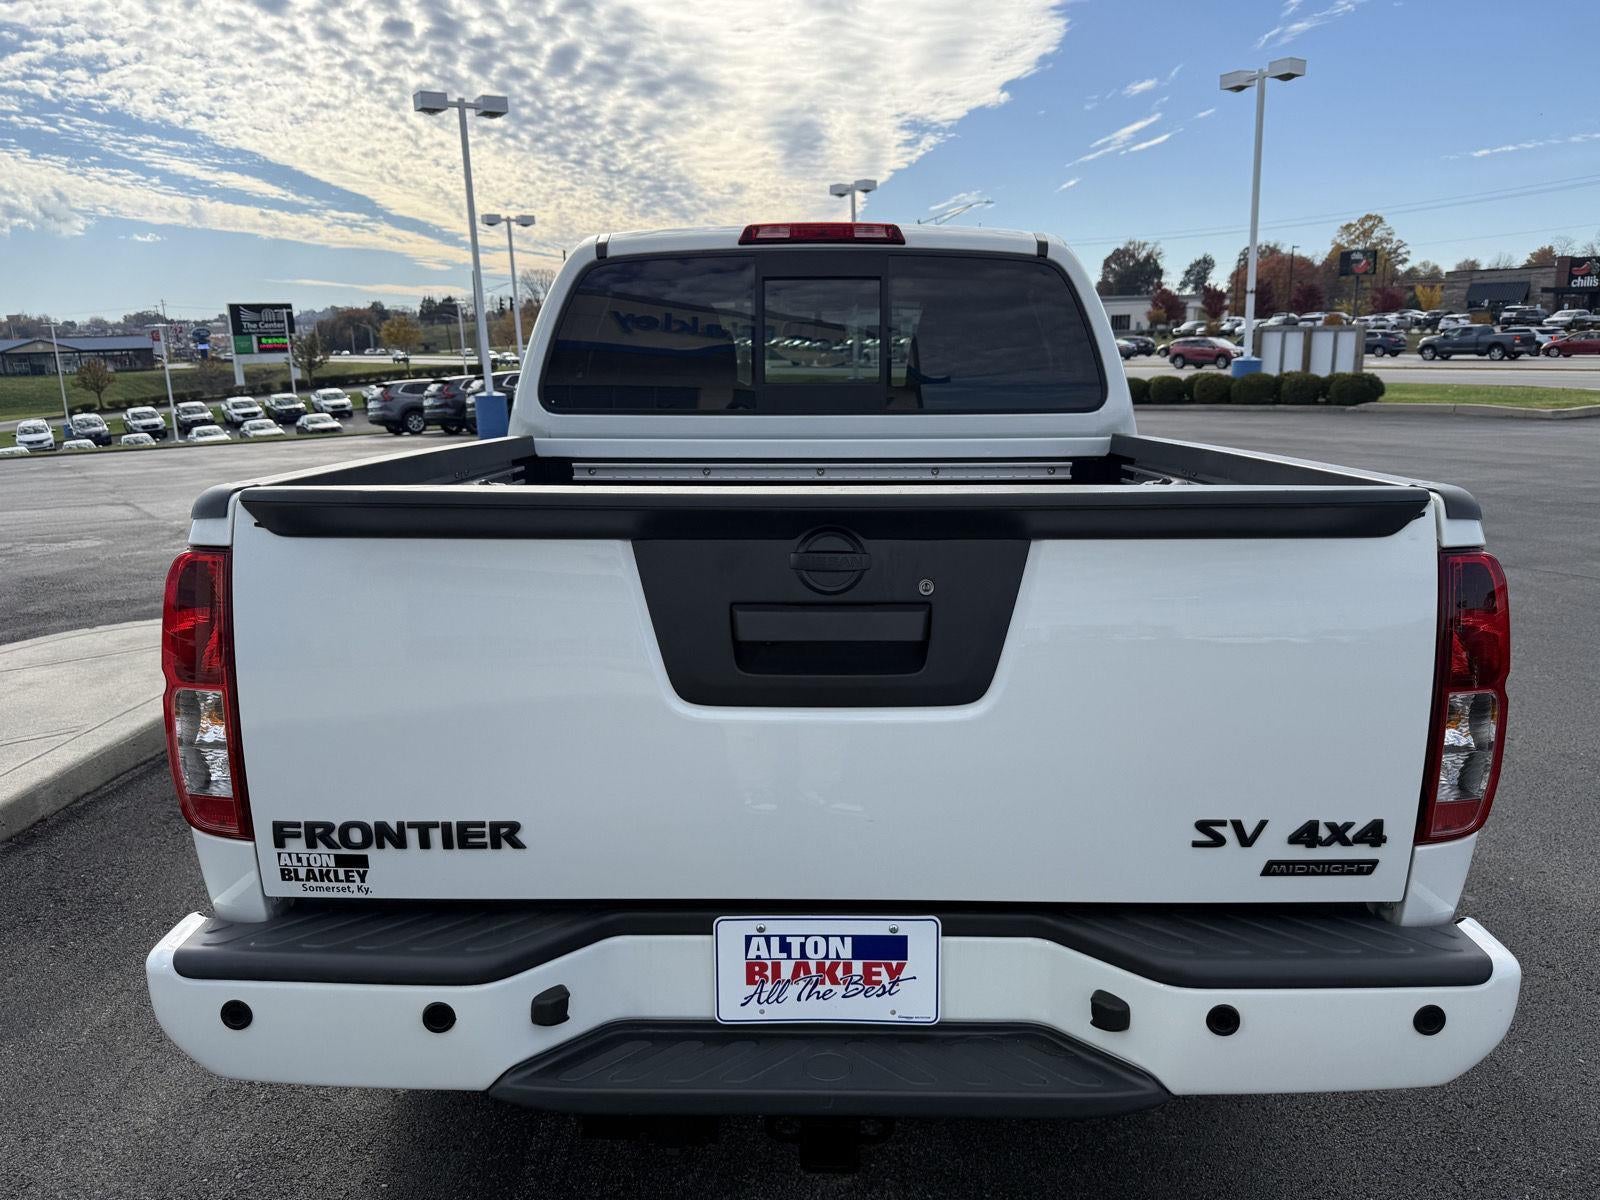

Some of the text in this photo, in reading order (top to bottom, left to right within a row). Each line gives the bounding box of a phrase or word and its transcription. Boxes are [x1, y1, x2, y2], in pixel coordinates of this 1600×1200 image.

[1571, 275, 1599, 288] chili's
[259, 321, 285, 329] Center
[272, 820, 527, 850] FRONTIER
[1191, 819, 1269, 848] SV
[279, 852, 336, 868] ALTON
[1269, 864, 1373, 873] MIDNIGHT
[279, 867, 369, 884] BLAKLEY
[301, 883, 373, 896] Somerset, Ky.
[746, 935, 852, 960] ALTON
[745, 960, 907, 987] BLAKLEY
[740, 974, 917, 1007] All The Best
